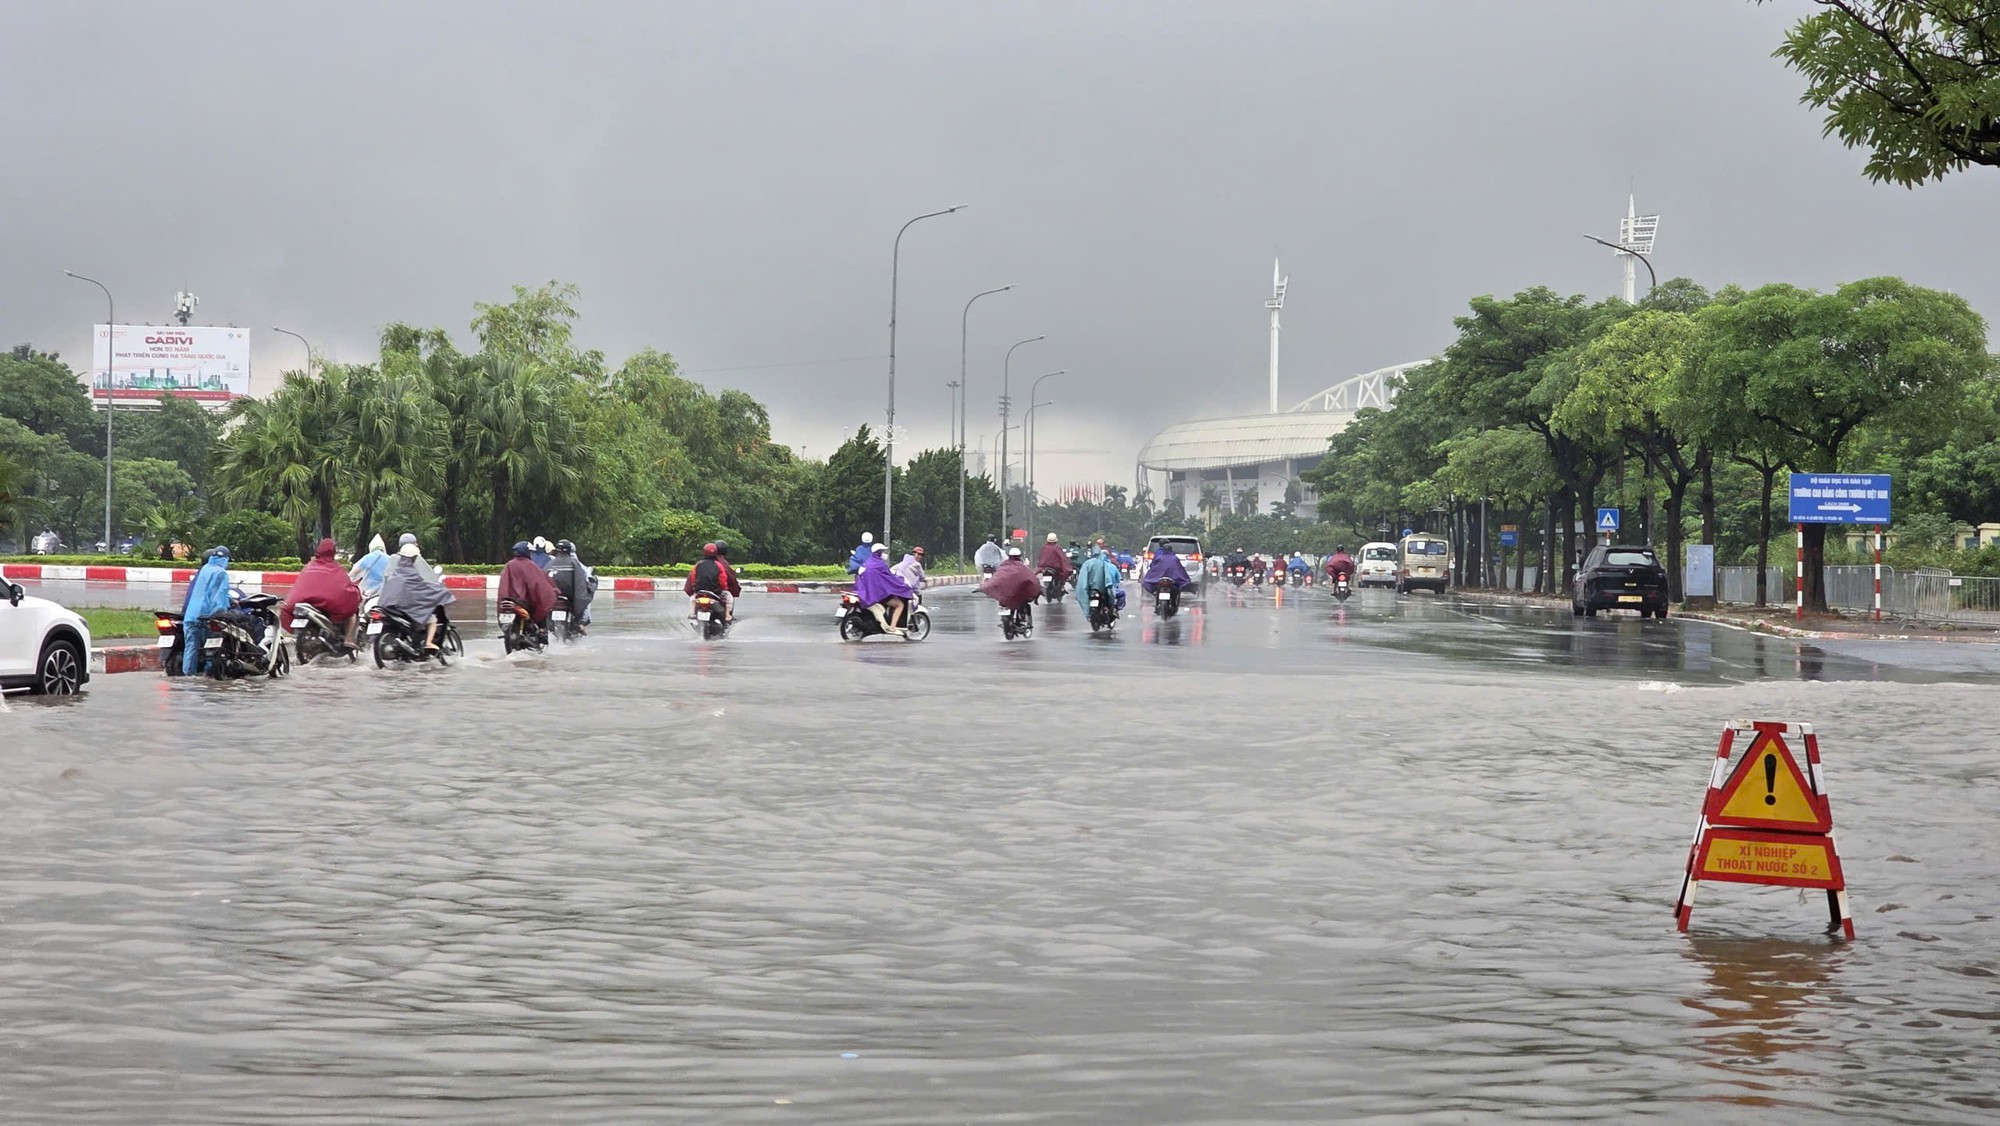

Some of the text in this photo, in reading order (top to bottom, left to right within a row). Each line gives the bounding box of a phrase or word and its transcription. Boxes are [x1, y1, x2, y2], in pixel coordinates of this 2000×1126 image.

[145, 336, 193, 344] CADIVI
[1740, 842, 1797, 860] XÍ NGHIỆP
[1718, 857, 1818, 875] THOÁT NƯỚC SỐ 2
